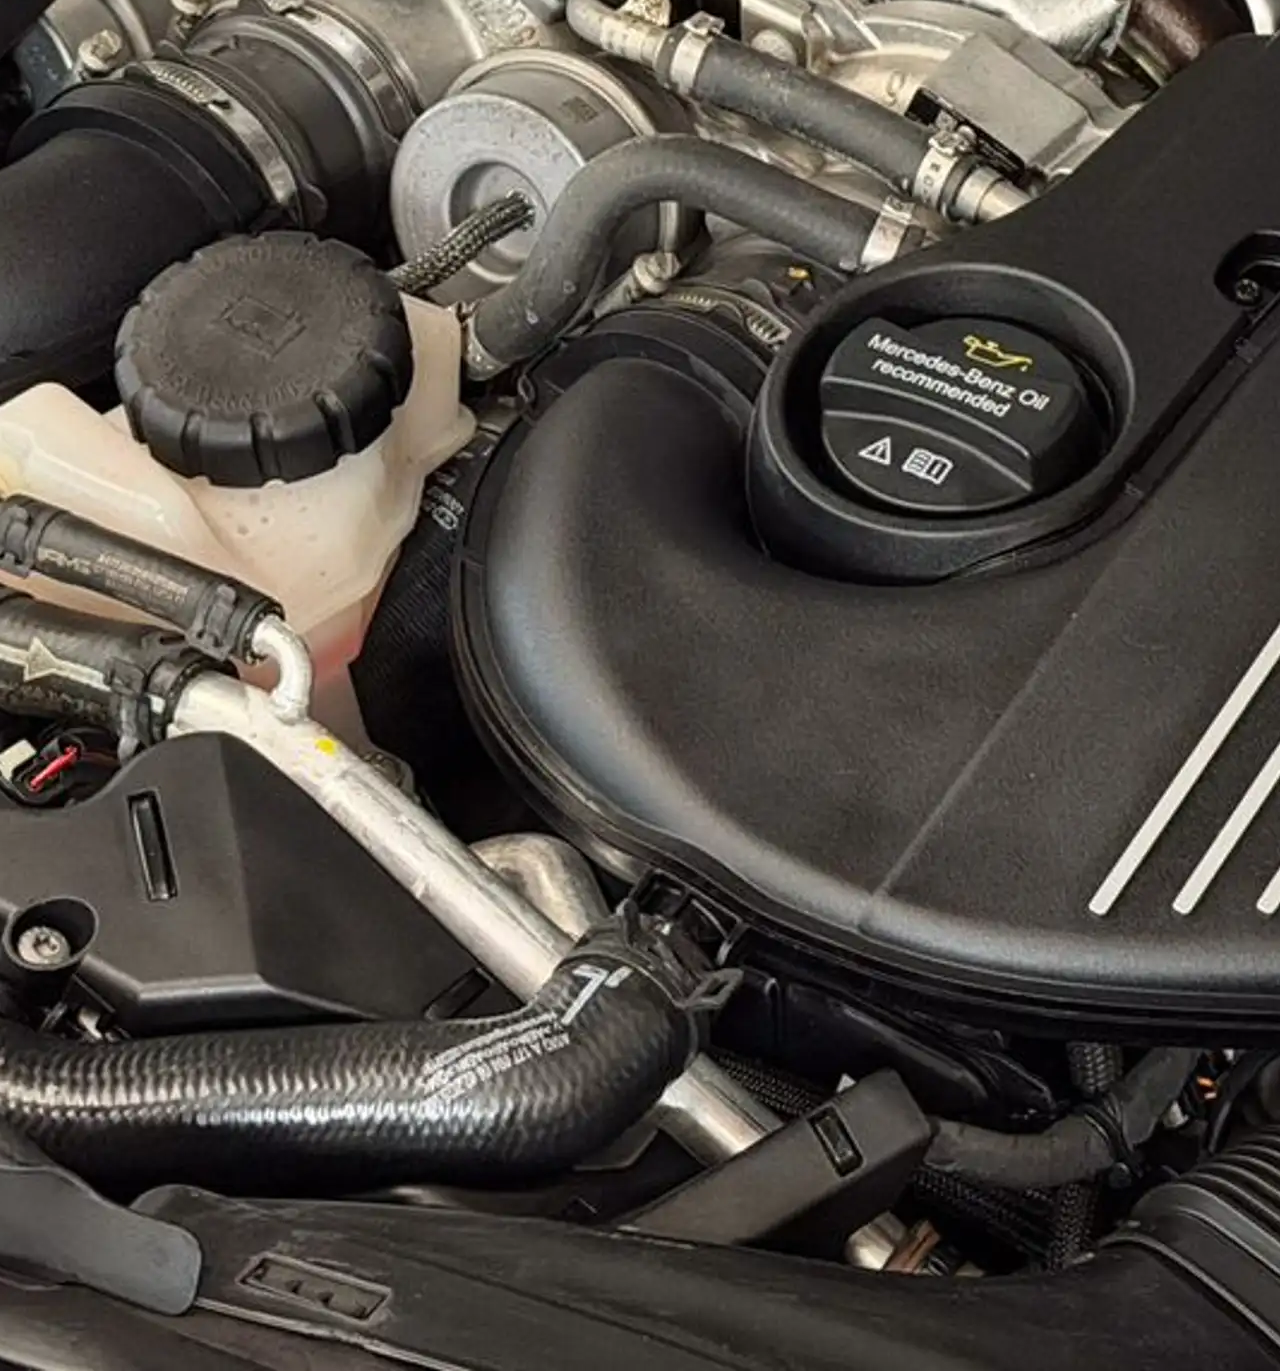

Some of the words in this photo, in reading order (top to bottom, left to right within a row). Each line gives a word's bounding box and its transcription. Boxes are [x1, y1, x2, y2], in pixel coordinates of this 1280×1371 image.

[868, 333, 1016, 398] Mercedes-Benz
[1019, 389, 1050, 411] Oil
[871, 358, 1011, 418] recommended
